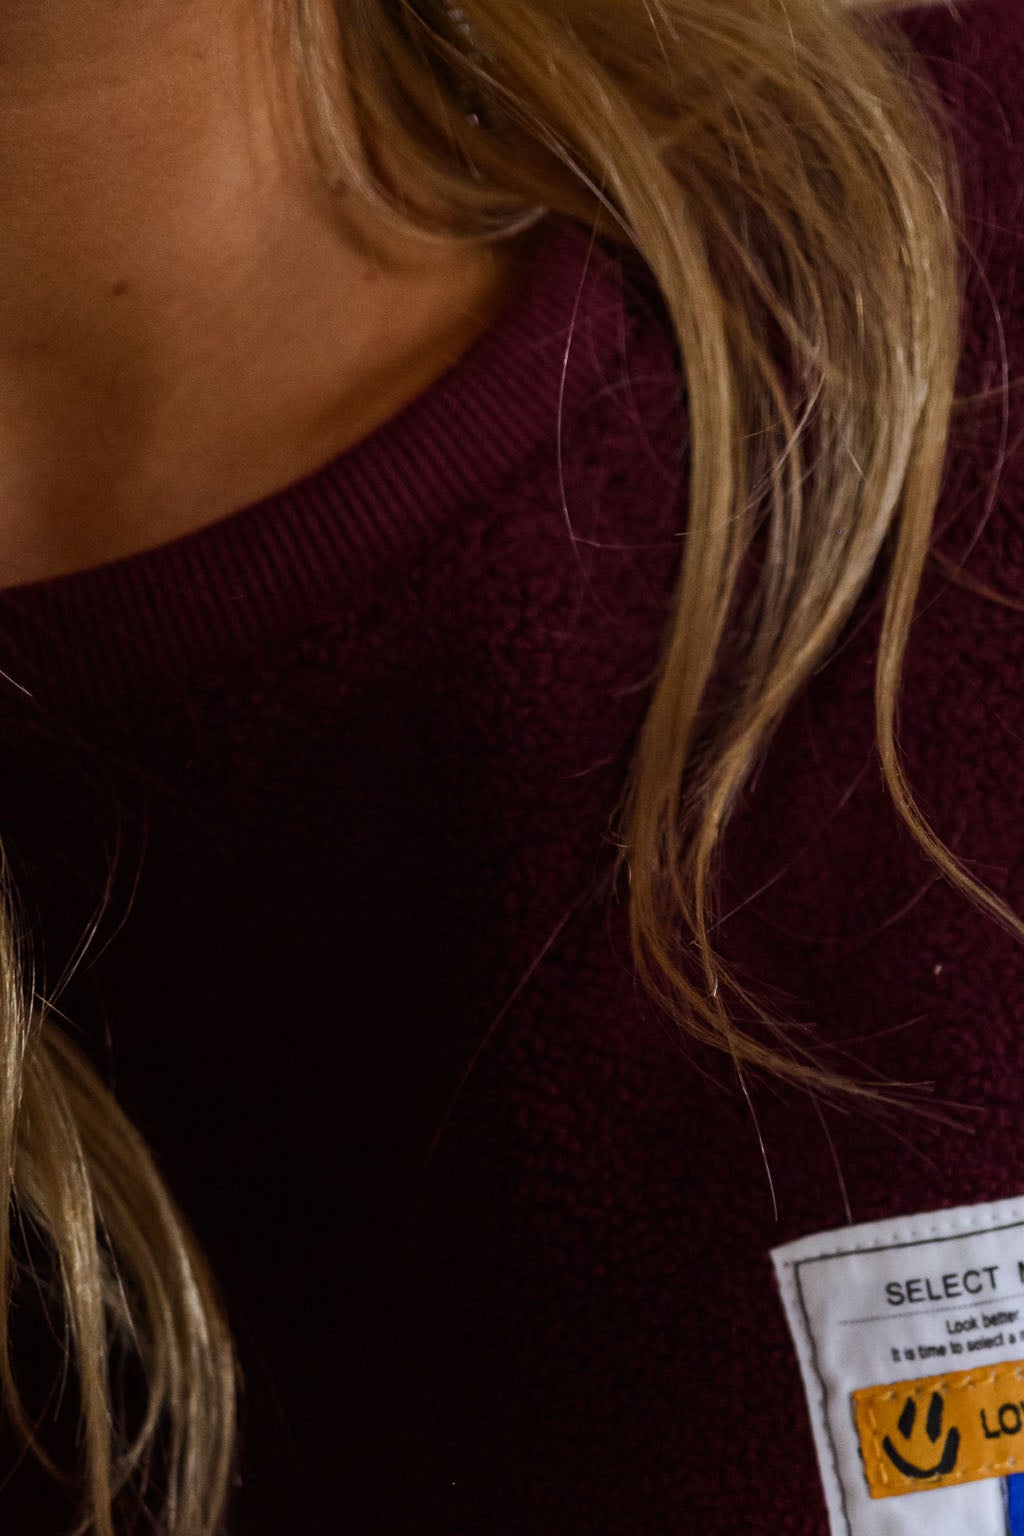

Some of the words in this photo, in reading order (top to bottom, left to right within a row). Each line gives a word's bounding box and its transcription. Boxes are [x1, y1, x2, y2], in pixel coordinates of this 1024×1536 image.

[885, 1265, 1000, 1307] SELECT
[945, 1318, 979, 1335] Look
[891, 1346, 902, 1362] It
[904, 1348, 916, 1361] is
[917, 1344, 947, 1359] time
[950, 1341, 963, 1355] to
[966, 1332, 1004, 1352] select
[1008, 1333, 1017, 1345] a
